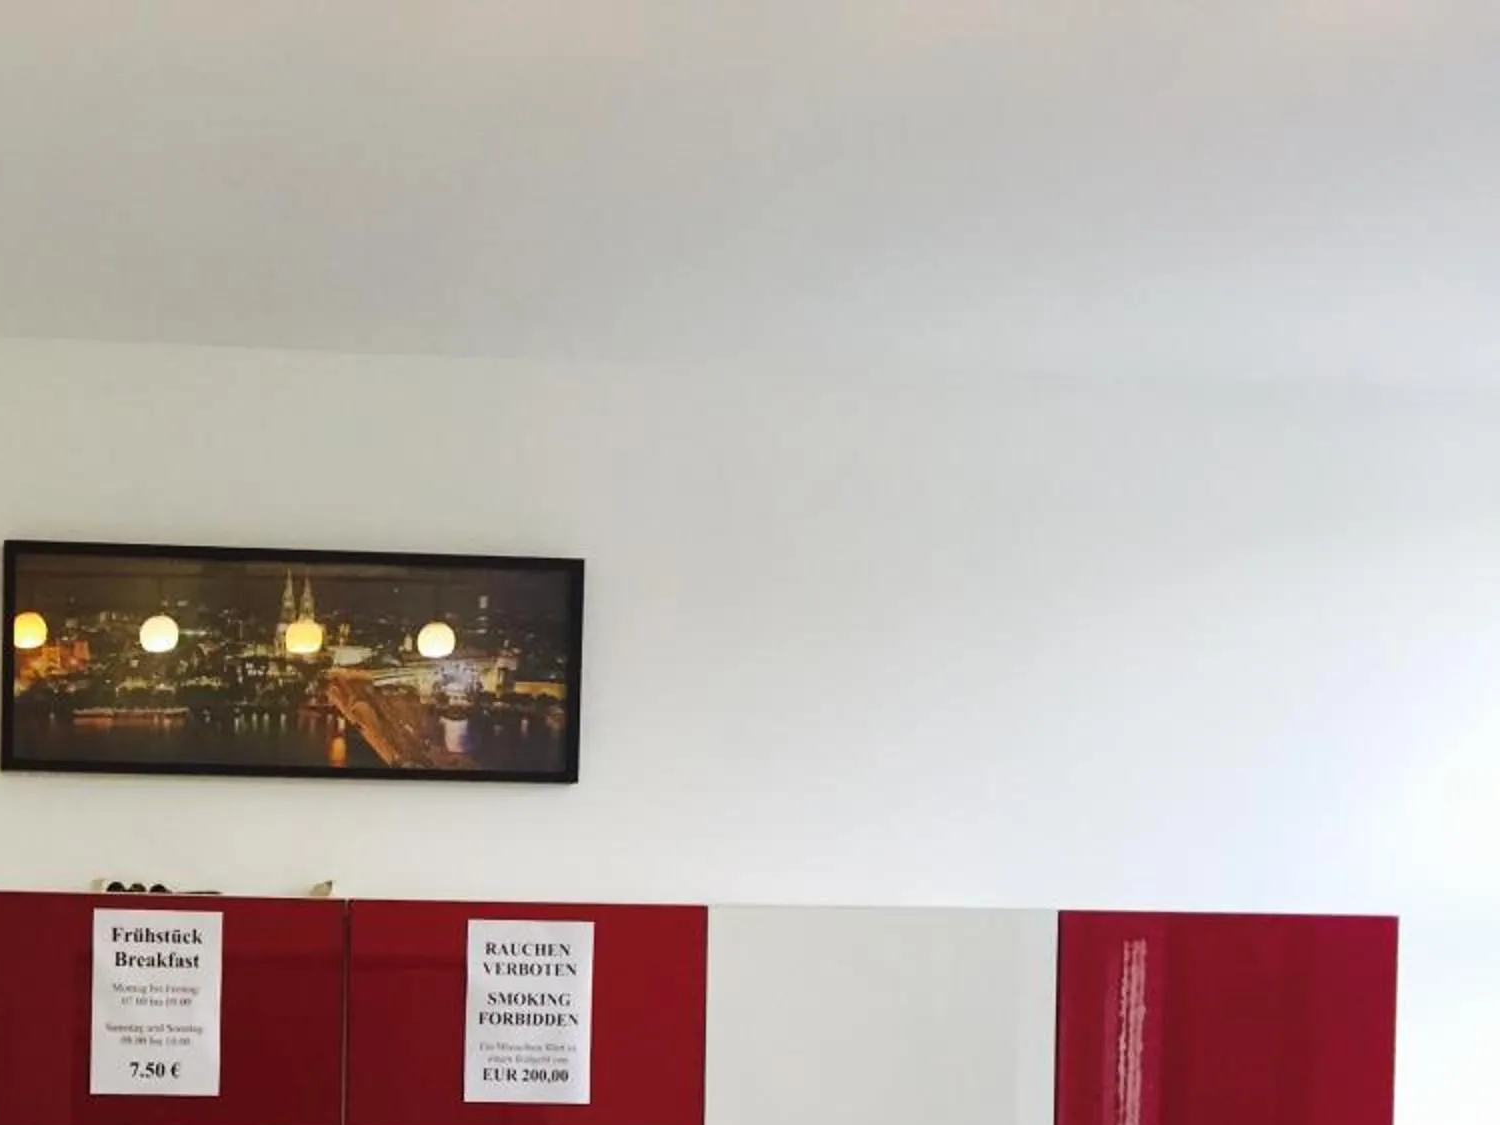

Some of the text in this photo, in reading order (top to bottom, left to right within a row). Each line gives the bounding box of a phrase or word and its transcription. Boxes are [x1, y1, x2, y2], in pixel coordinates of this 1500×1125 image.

[111, 927, 203, 945] Frühstück
[485, 942, 571, 957] RAUCHEN
[115, 951, 200, 969] Breakfast
[483, 962, 577, 977] VERBOTEN
[487, 992, 571, 1007] SMOKING
[479, 1011, 579, 1026] FORBIDDEN
[130, 1062, 181, 1079] 7.50 €
[483, 1068, 569, 1084] EUR 200,00
